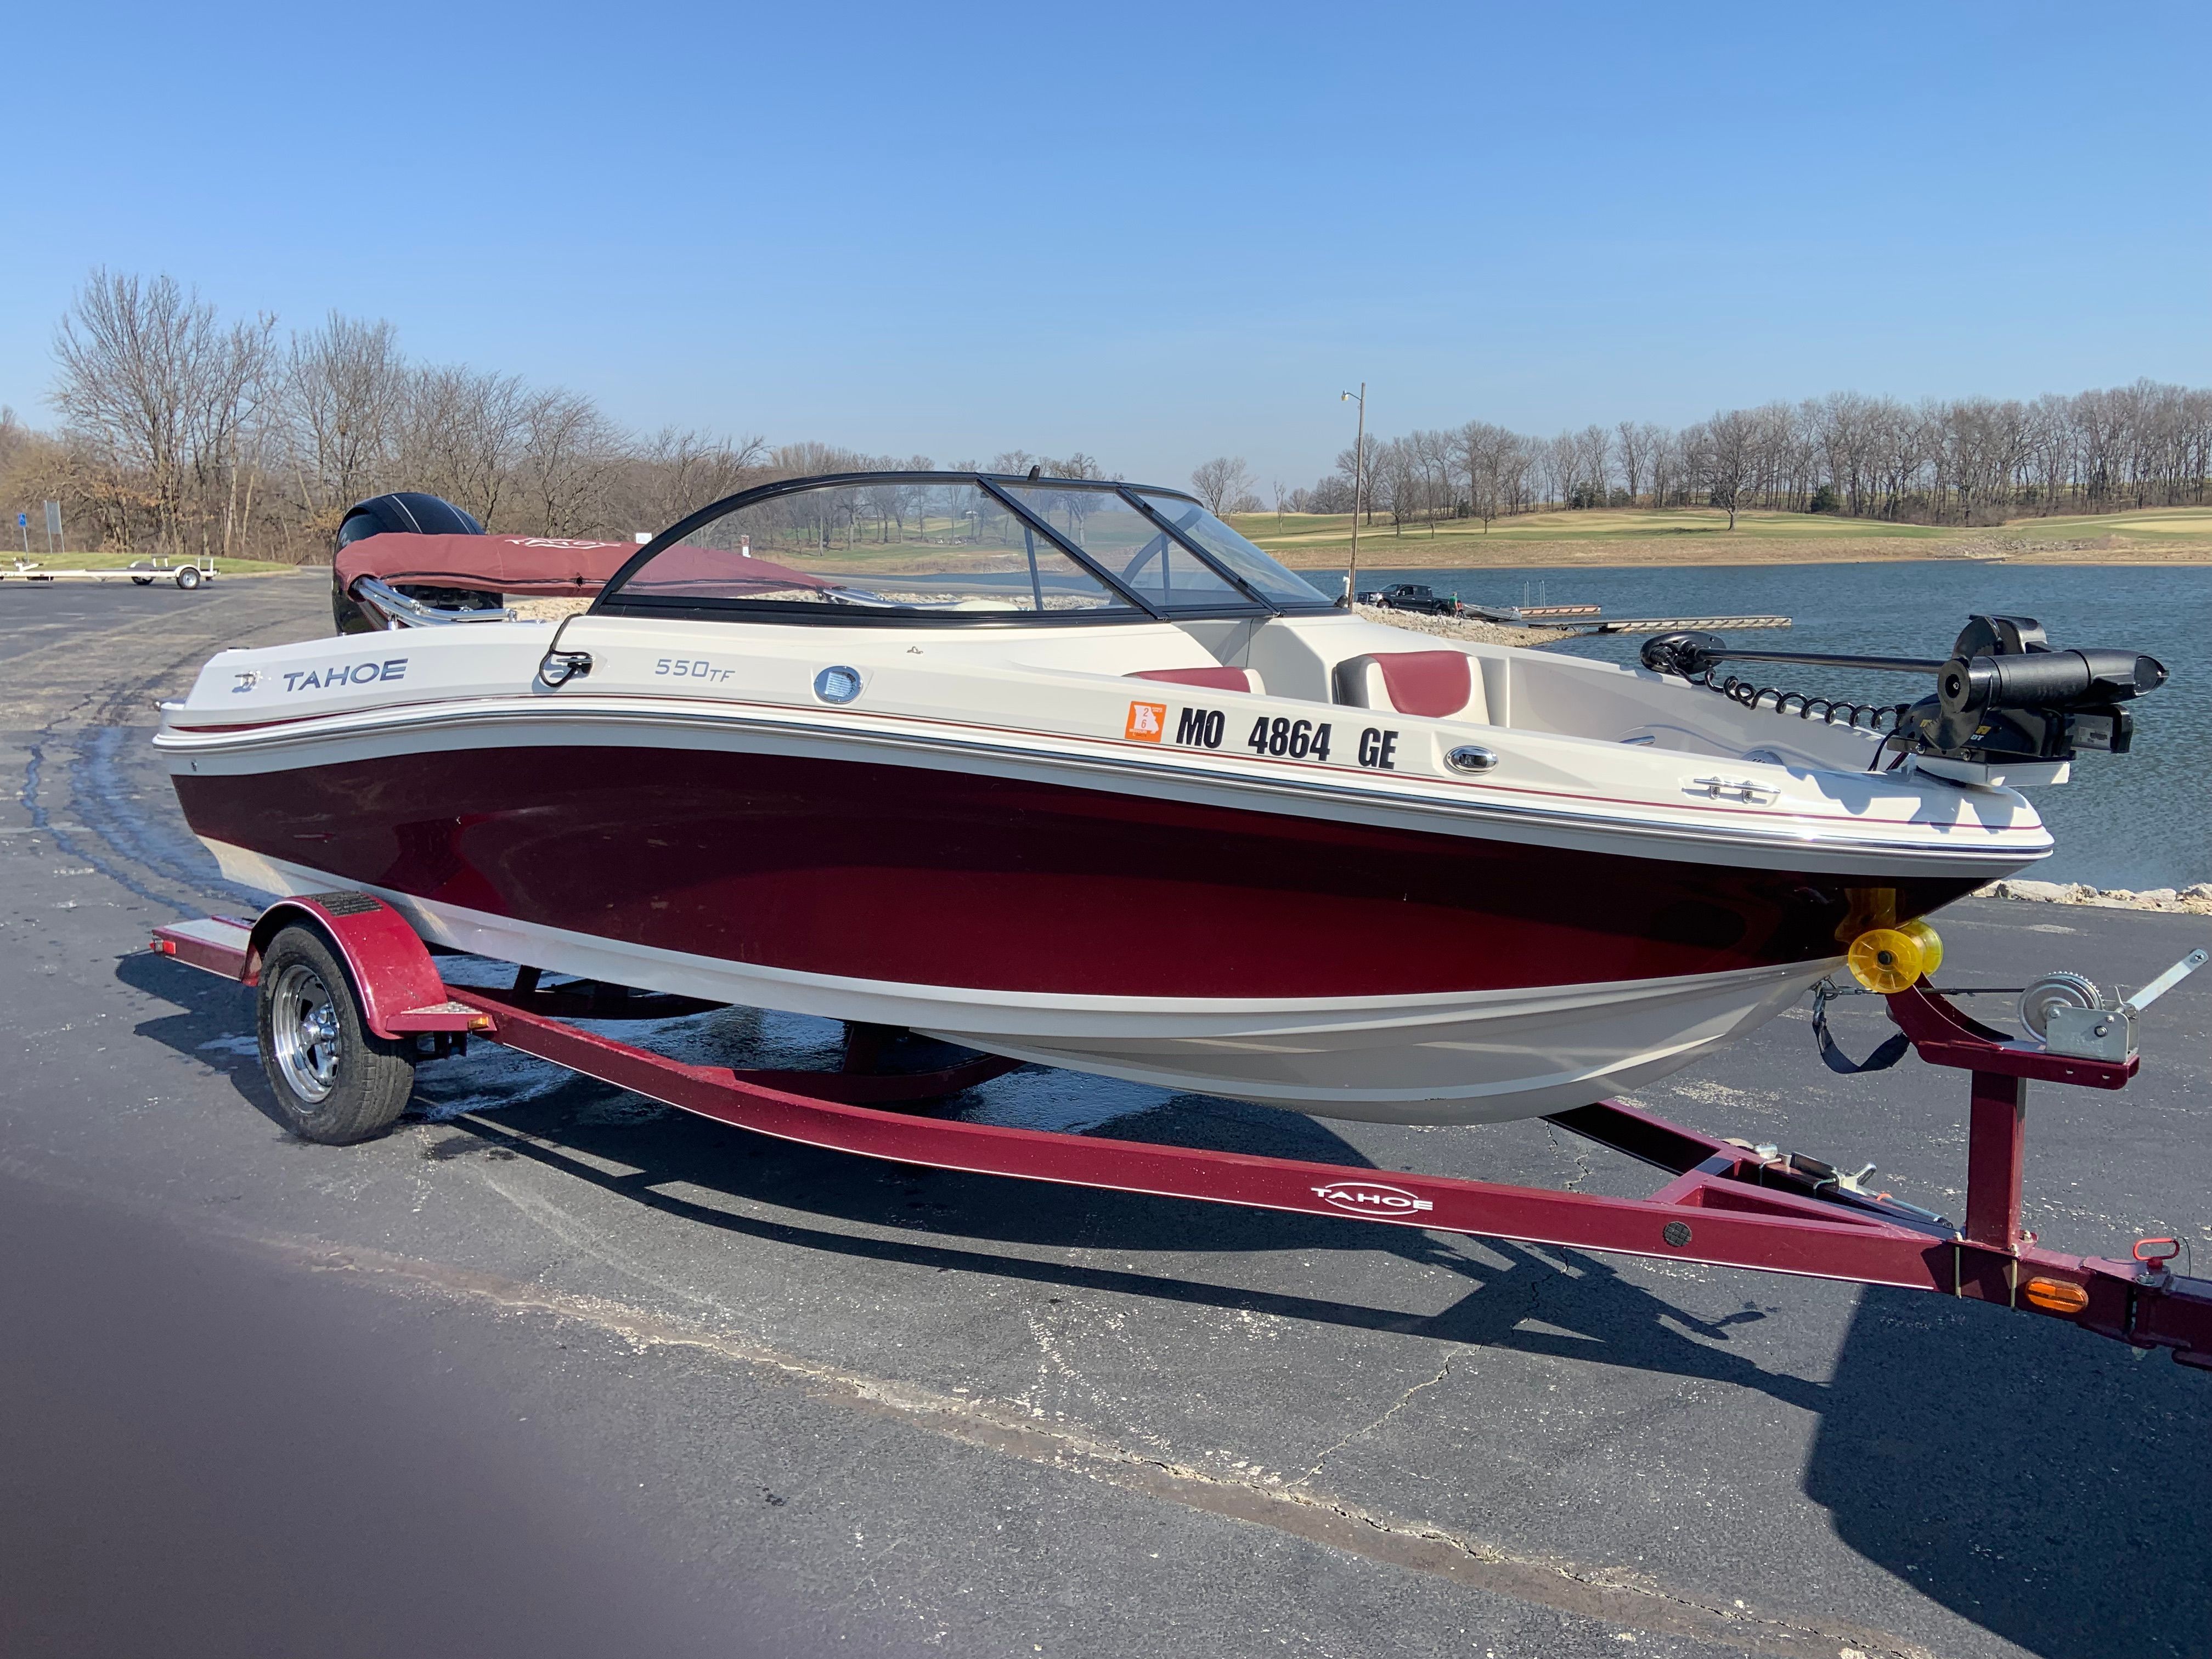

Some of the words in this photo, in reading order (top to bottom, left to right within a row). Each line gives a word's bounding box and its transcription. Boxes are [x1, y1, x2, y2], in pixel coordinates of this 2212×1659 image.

[283, 658, 409, 692] TAHOE
[1141, 719, 1147, 729] 6
[1143, 707, 1149, 717] 2
[1176, 707, 1226, 749] MO
[1248, 716, 1332, 761] 4864
[1358, 727, 1399, 770] GE
[1310, 1187, 1434, 1211] TAHOE
